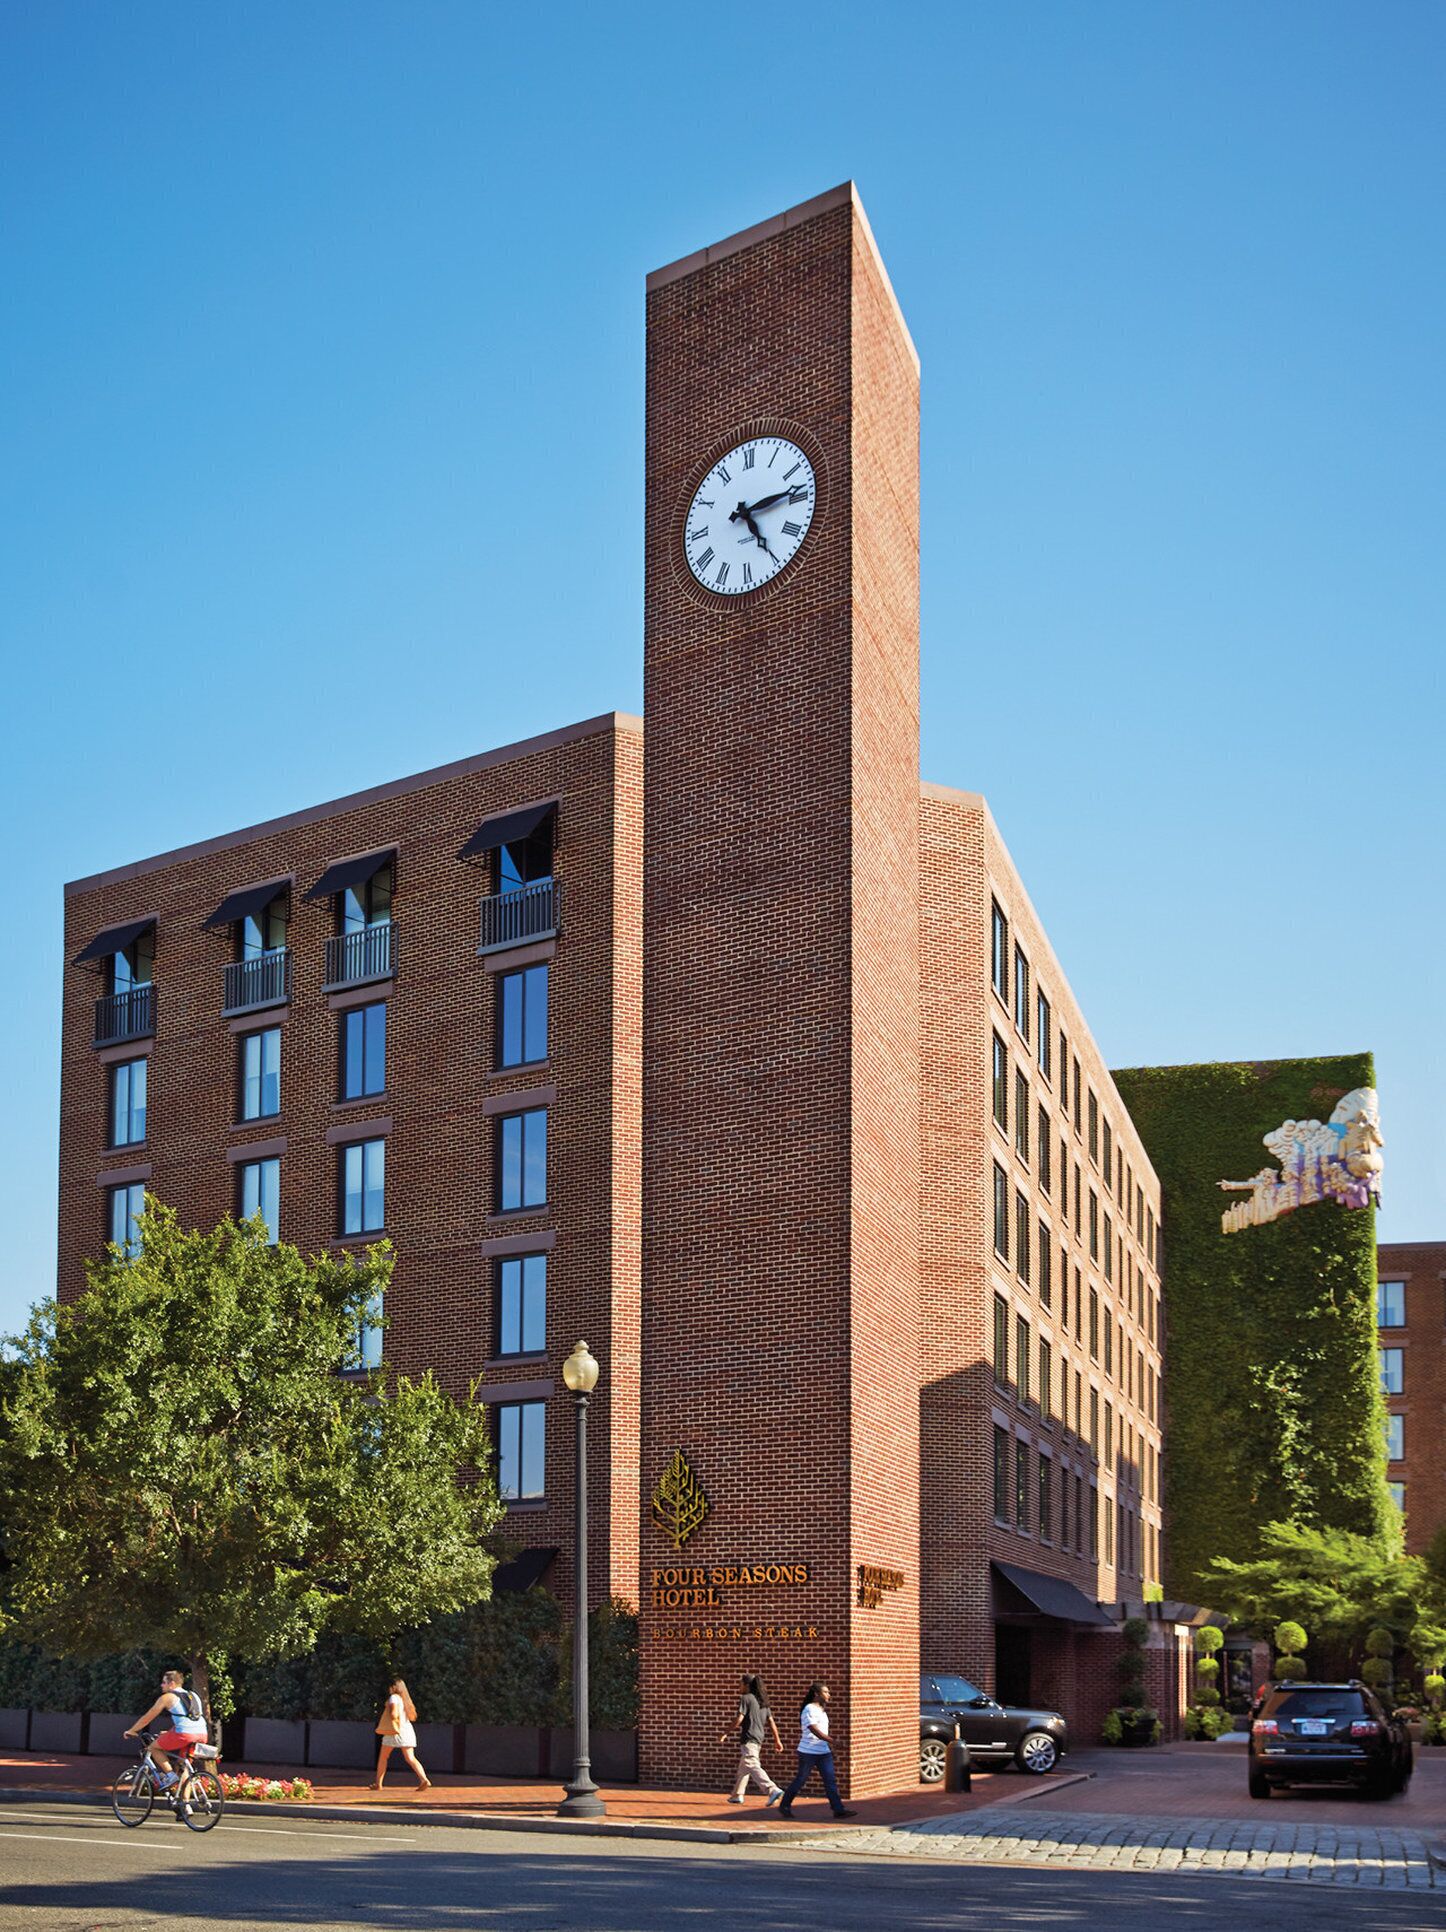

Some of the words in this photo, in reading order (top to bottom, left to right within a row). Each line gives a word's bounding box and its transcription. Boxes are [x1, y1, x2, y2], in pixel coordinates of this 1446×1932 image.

[652, 1568, 706, 1587] FOUR
[711, 1564, 808, 1585] SEASONS
[652, 1588, 720, 1607] HOTEL
[653, 1628, 741, 1639] BOURBON
[754, 1626, 818, 1638] STEAK
